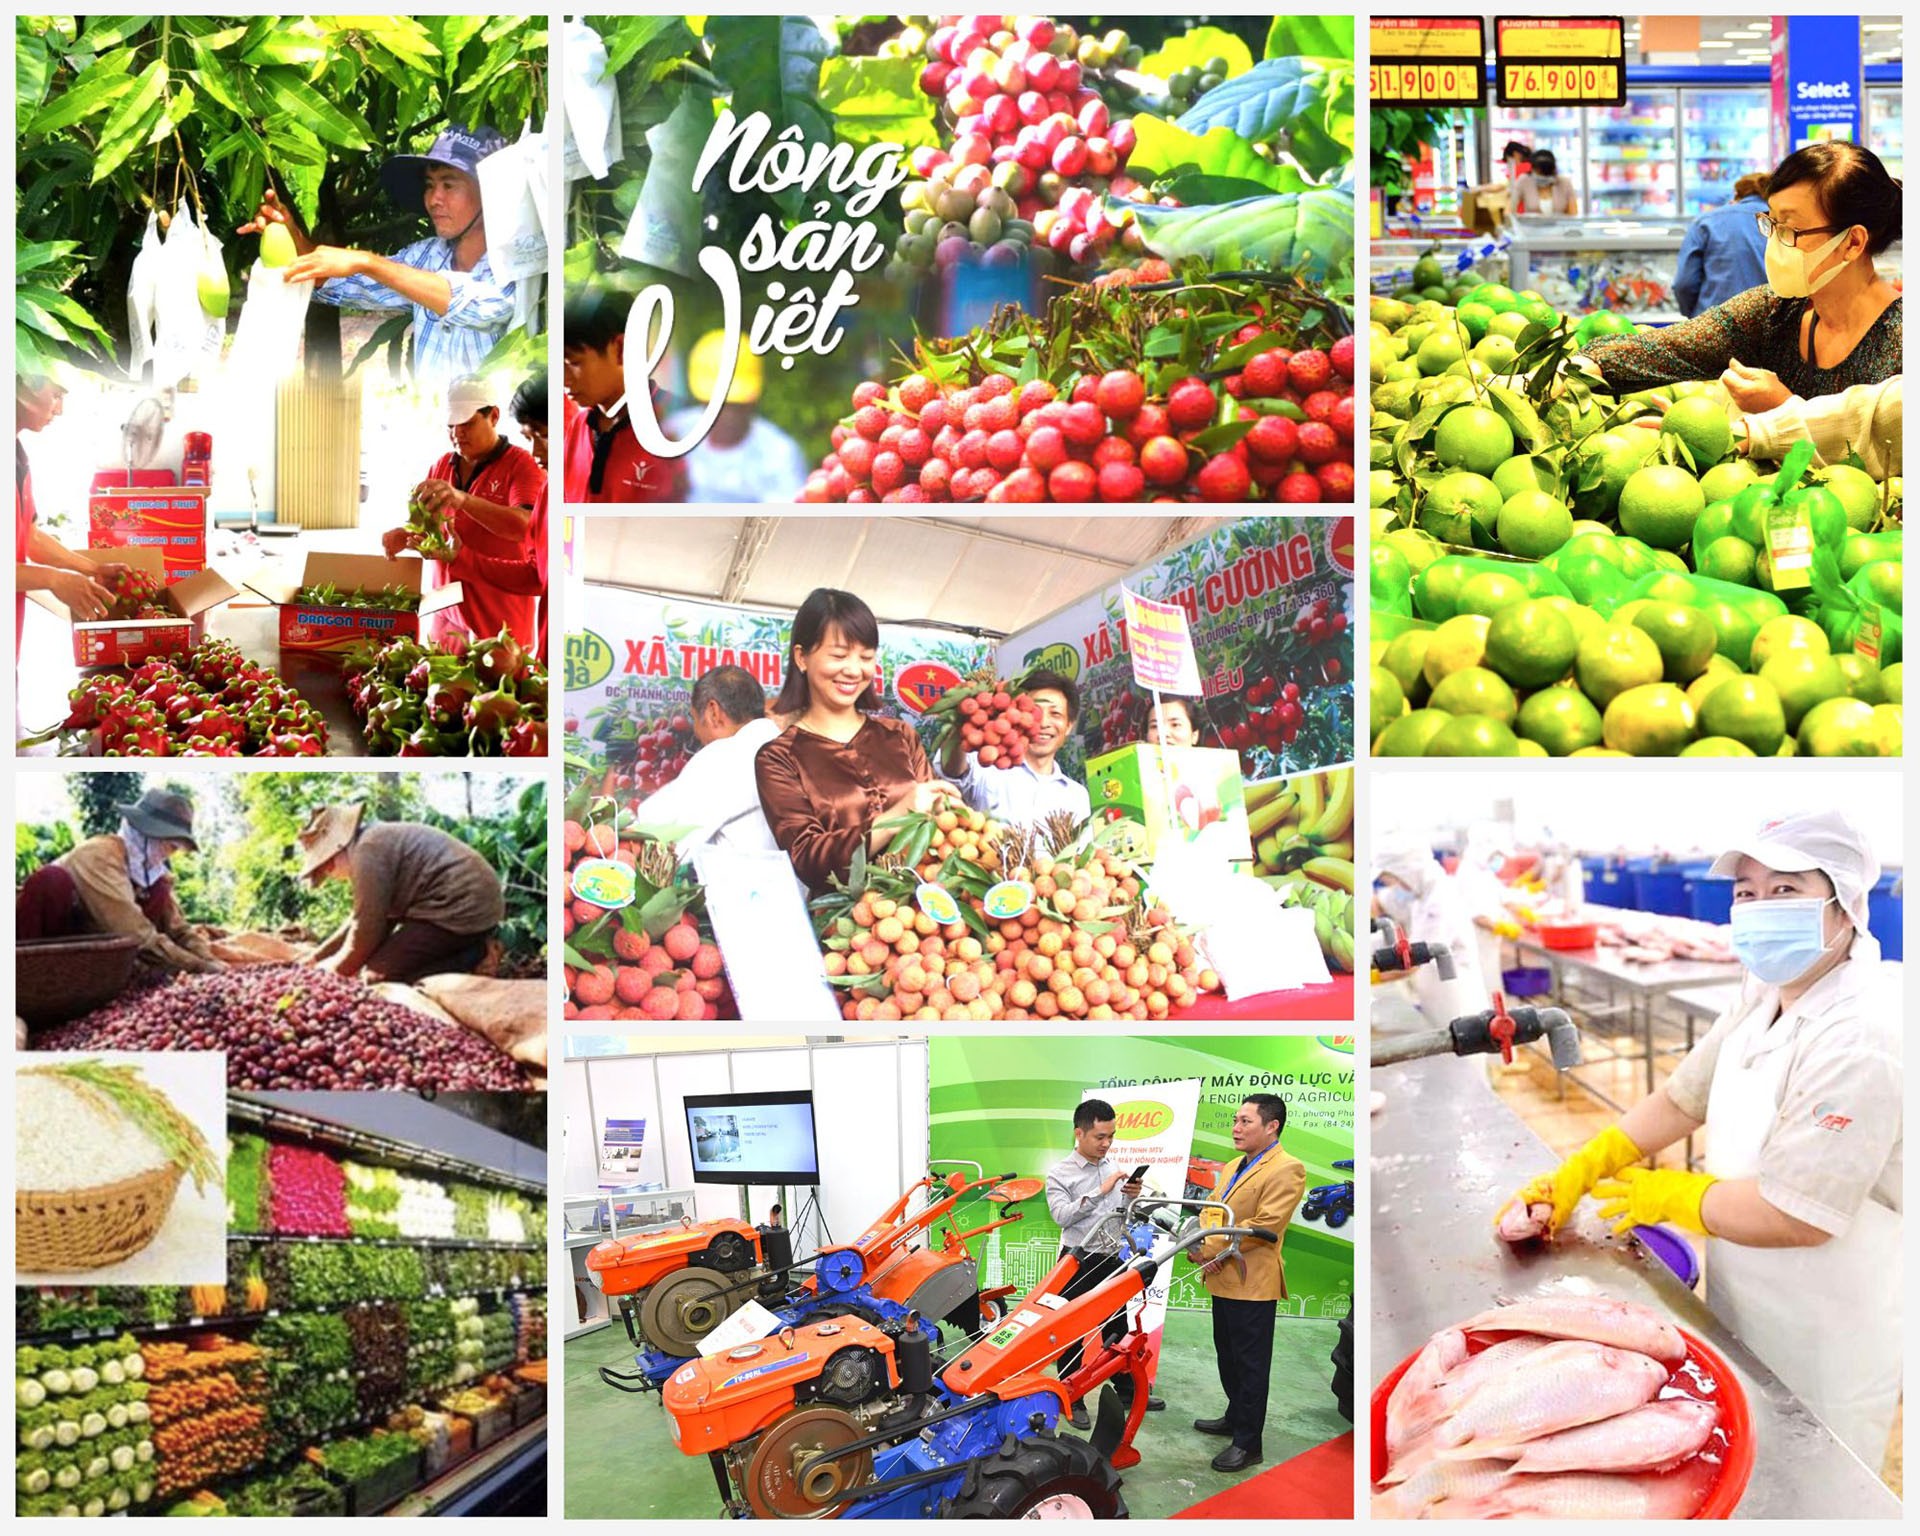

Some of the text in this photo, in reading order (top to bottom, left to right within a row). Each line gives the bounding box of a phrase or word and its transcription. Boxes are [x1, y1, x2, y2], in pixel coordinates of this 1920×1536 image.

[1508, 70, 1596, 93] 76.900
[1797, 81, 1851, 99] Select
[1204, 534, 1315, 615] CƯỜNG
[298, 613, 396, 630] DRAGON FRUIT
[1083, 621, 1114, 669] XÃ
[623, 635, 669, 677] XÃ
[1211, 1072, 1245, 1087] MÁY
[1250, 1072, 1294, 1088] ĐỘNG
[1300, 1071, 1332, 1088] LỰC
[1115, 1111, 1164, 1129] AMAC
[1147, 1285, 1164, 1299] ỐC
